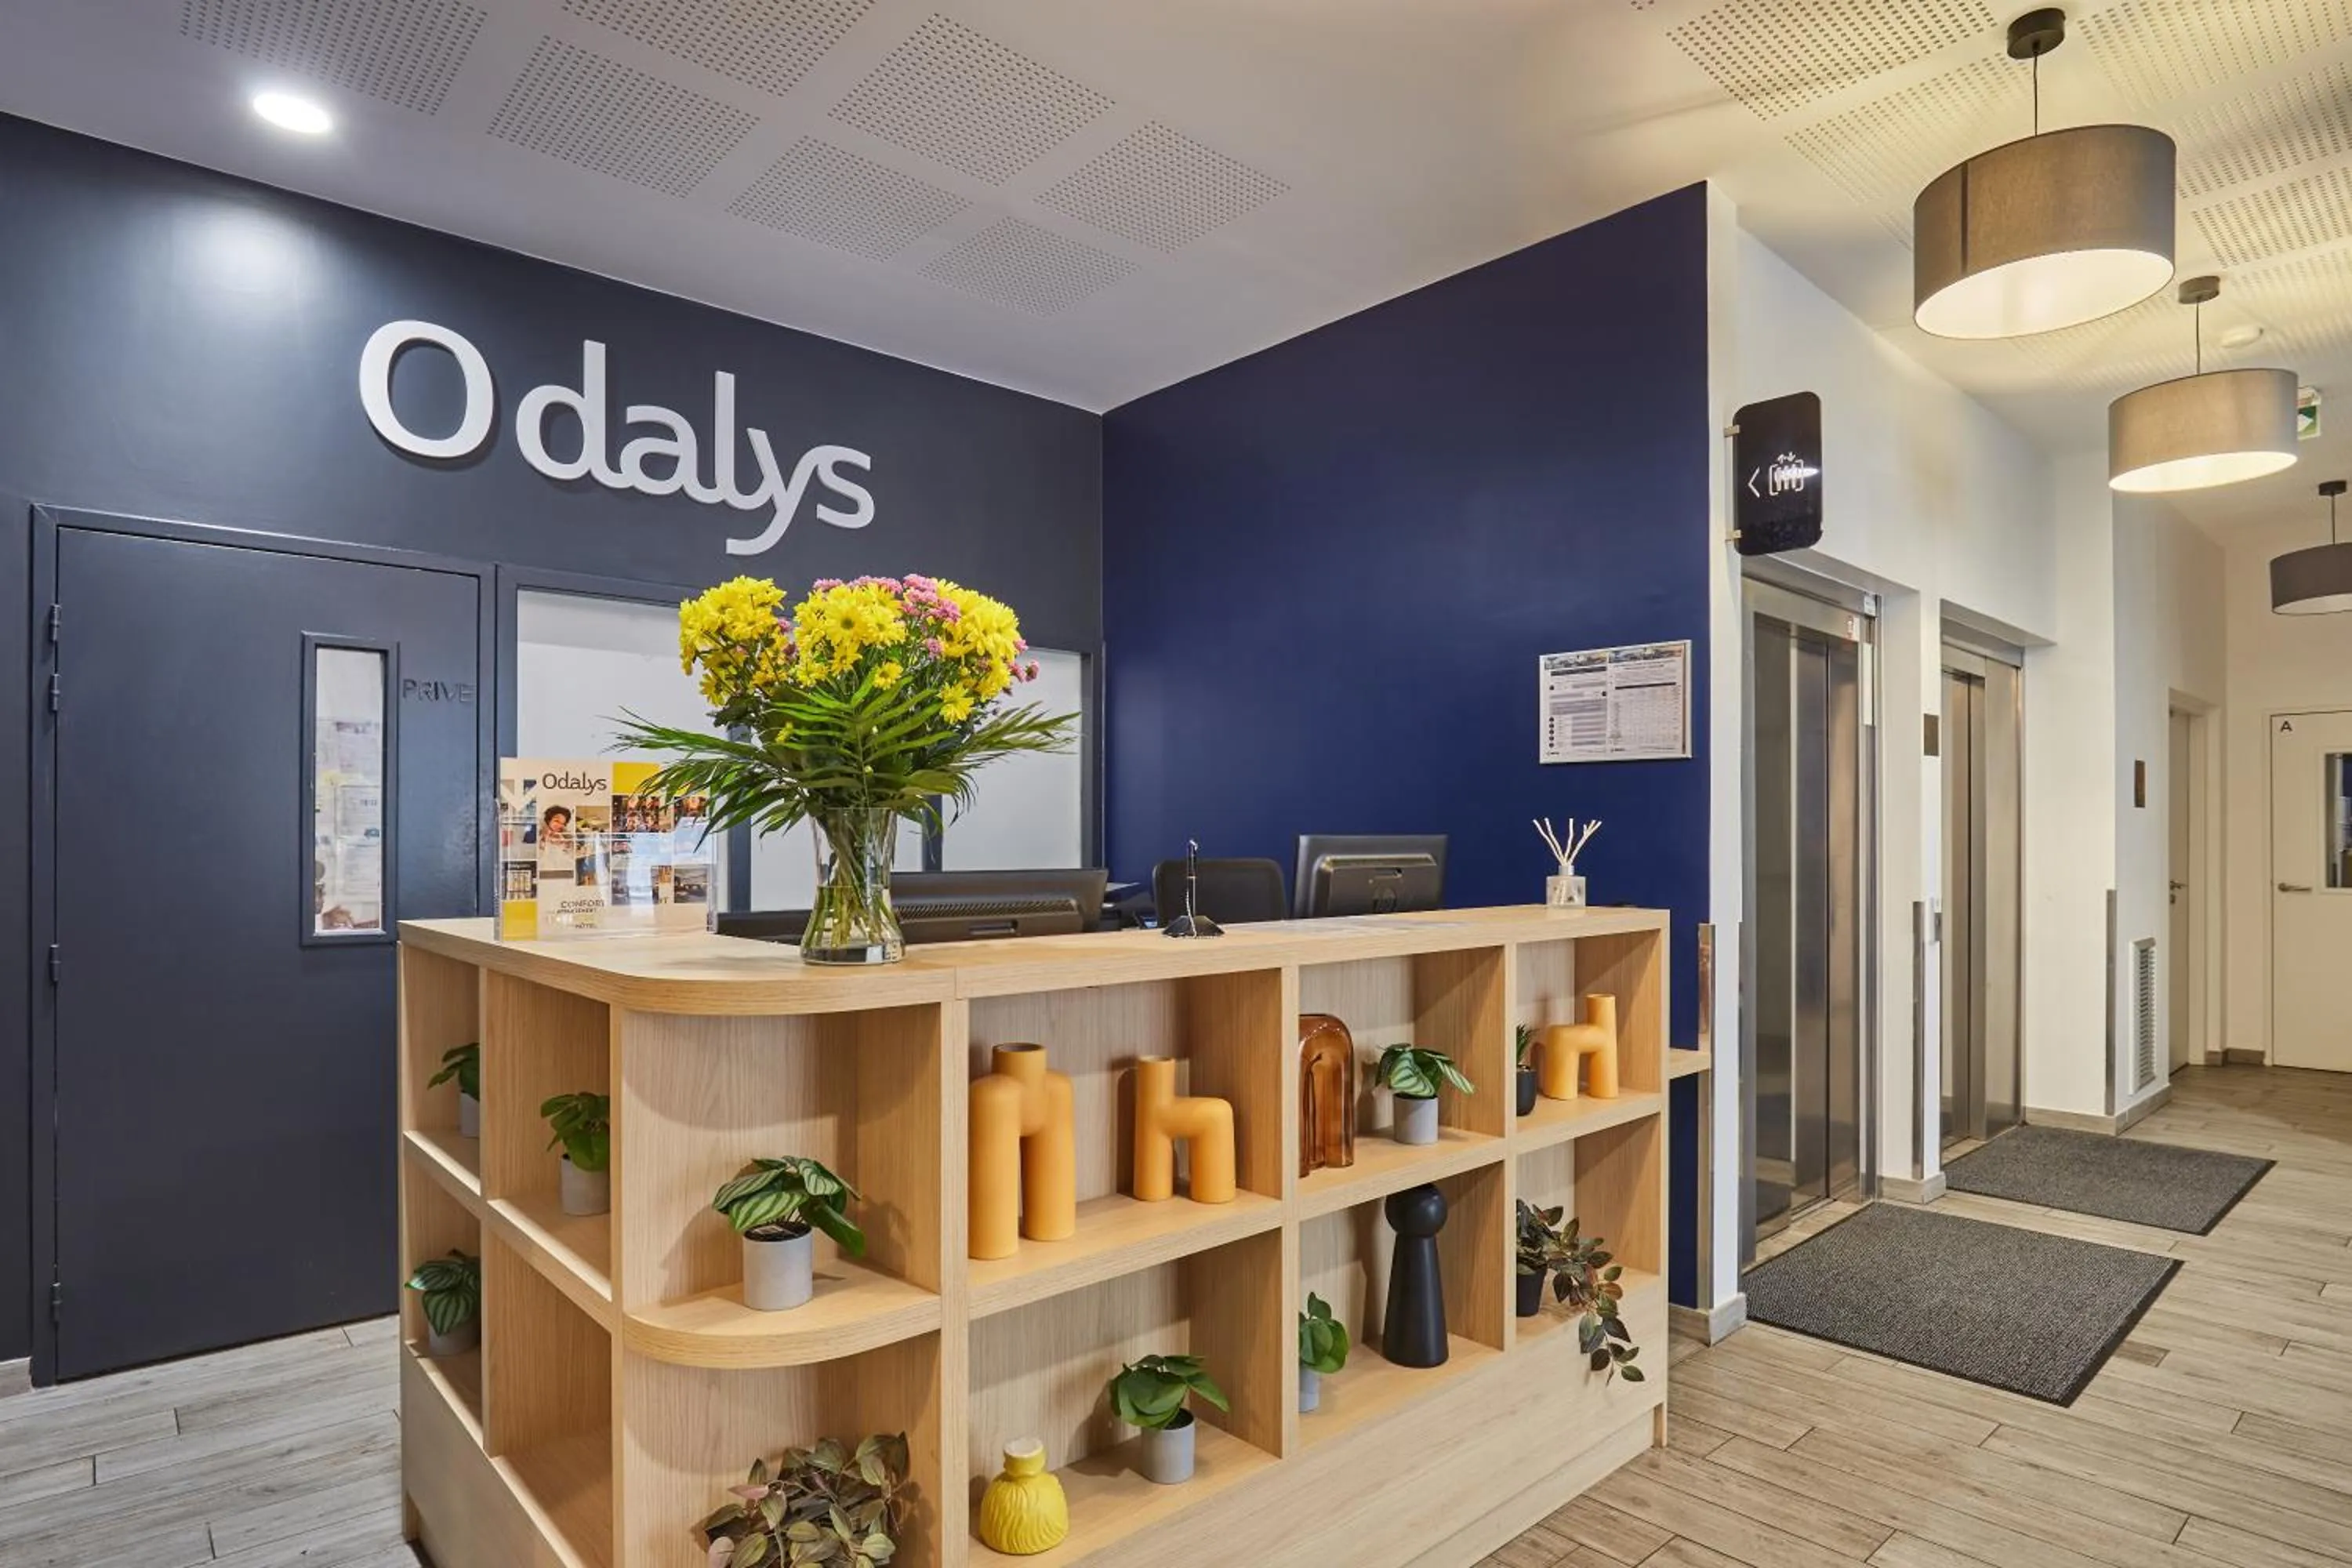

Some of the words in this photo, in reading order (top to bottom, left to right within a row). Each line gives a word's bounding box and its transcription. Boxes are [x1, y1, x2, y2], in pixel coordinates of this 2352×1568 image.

[358, 319, 875, 555] Odalys
[402, 678, 475, 703] PRIVE
[2280, 720, 2293, 732] A
[543, 771, 607, 795] Odalys
